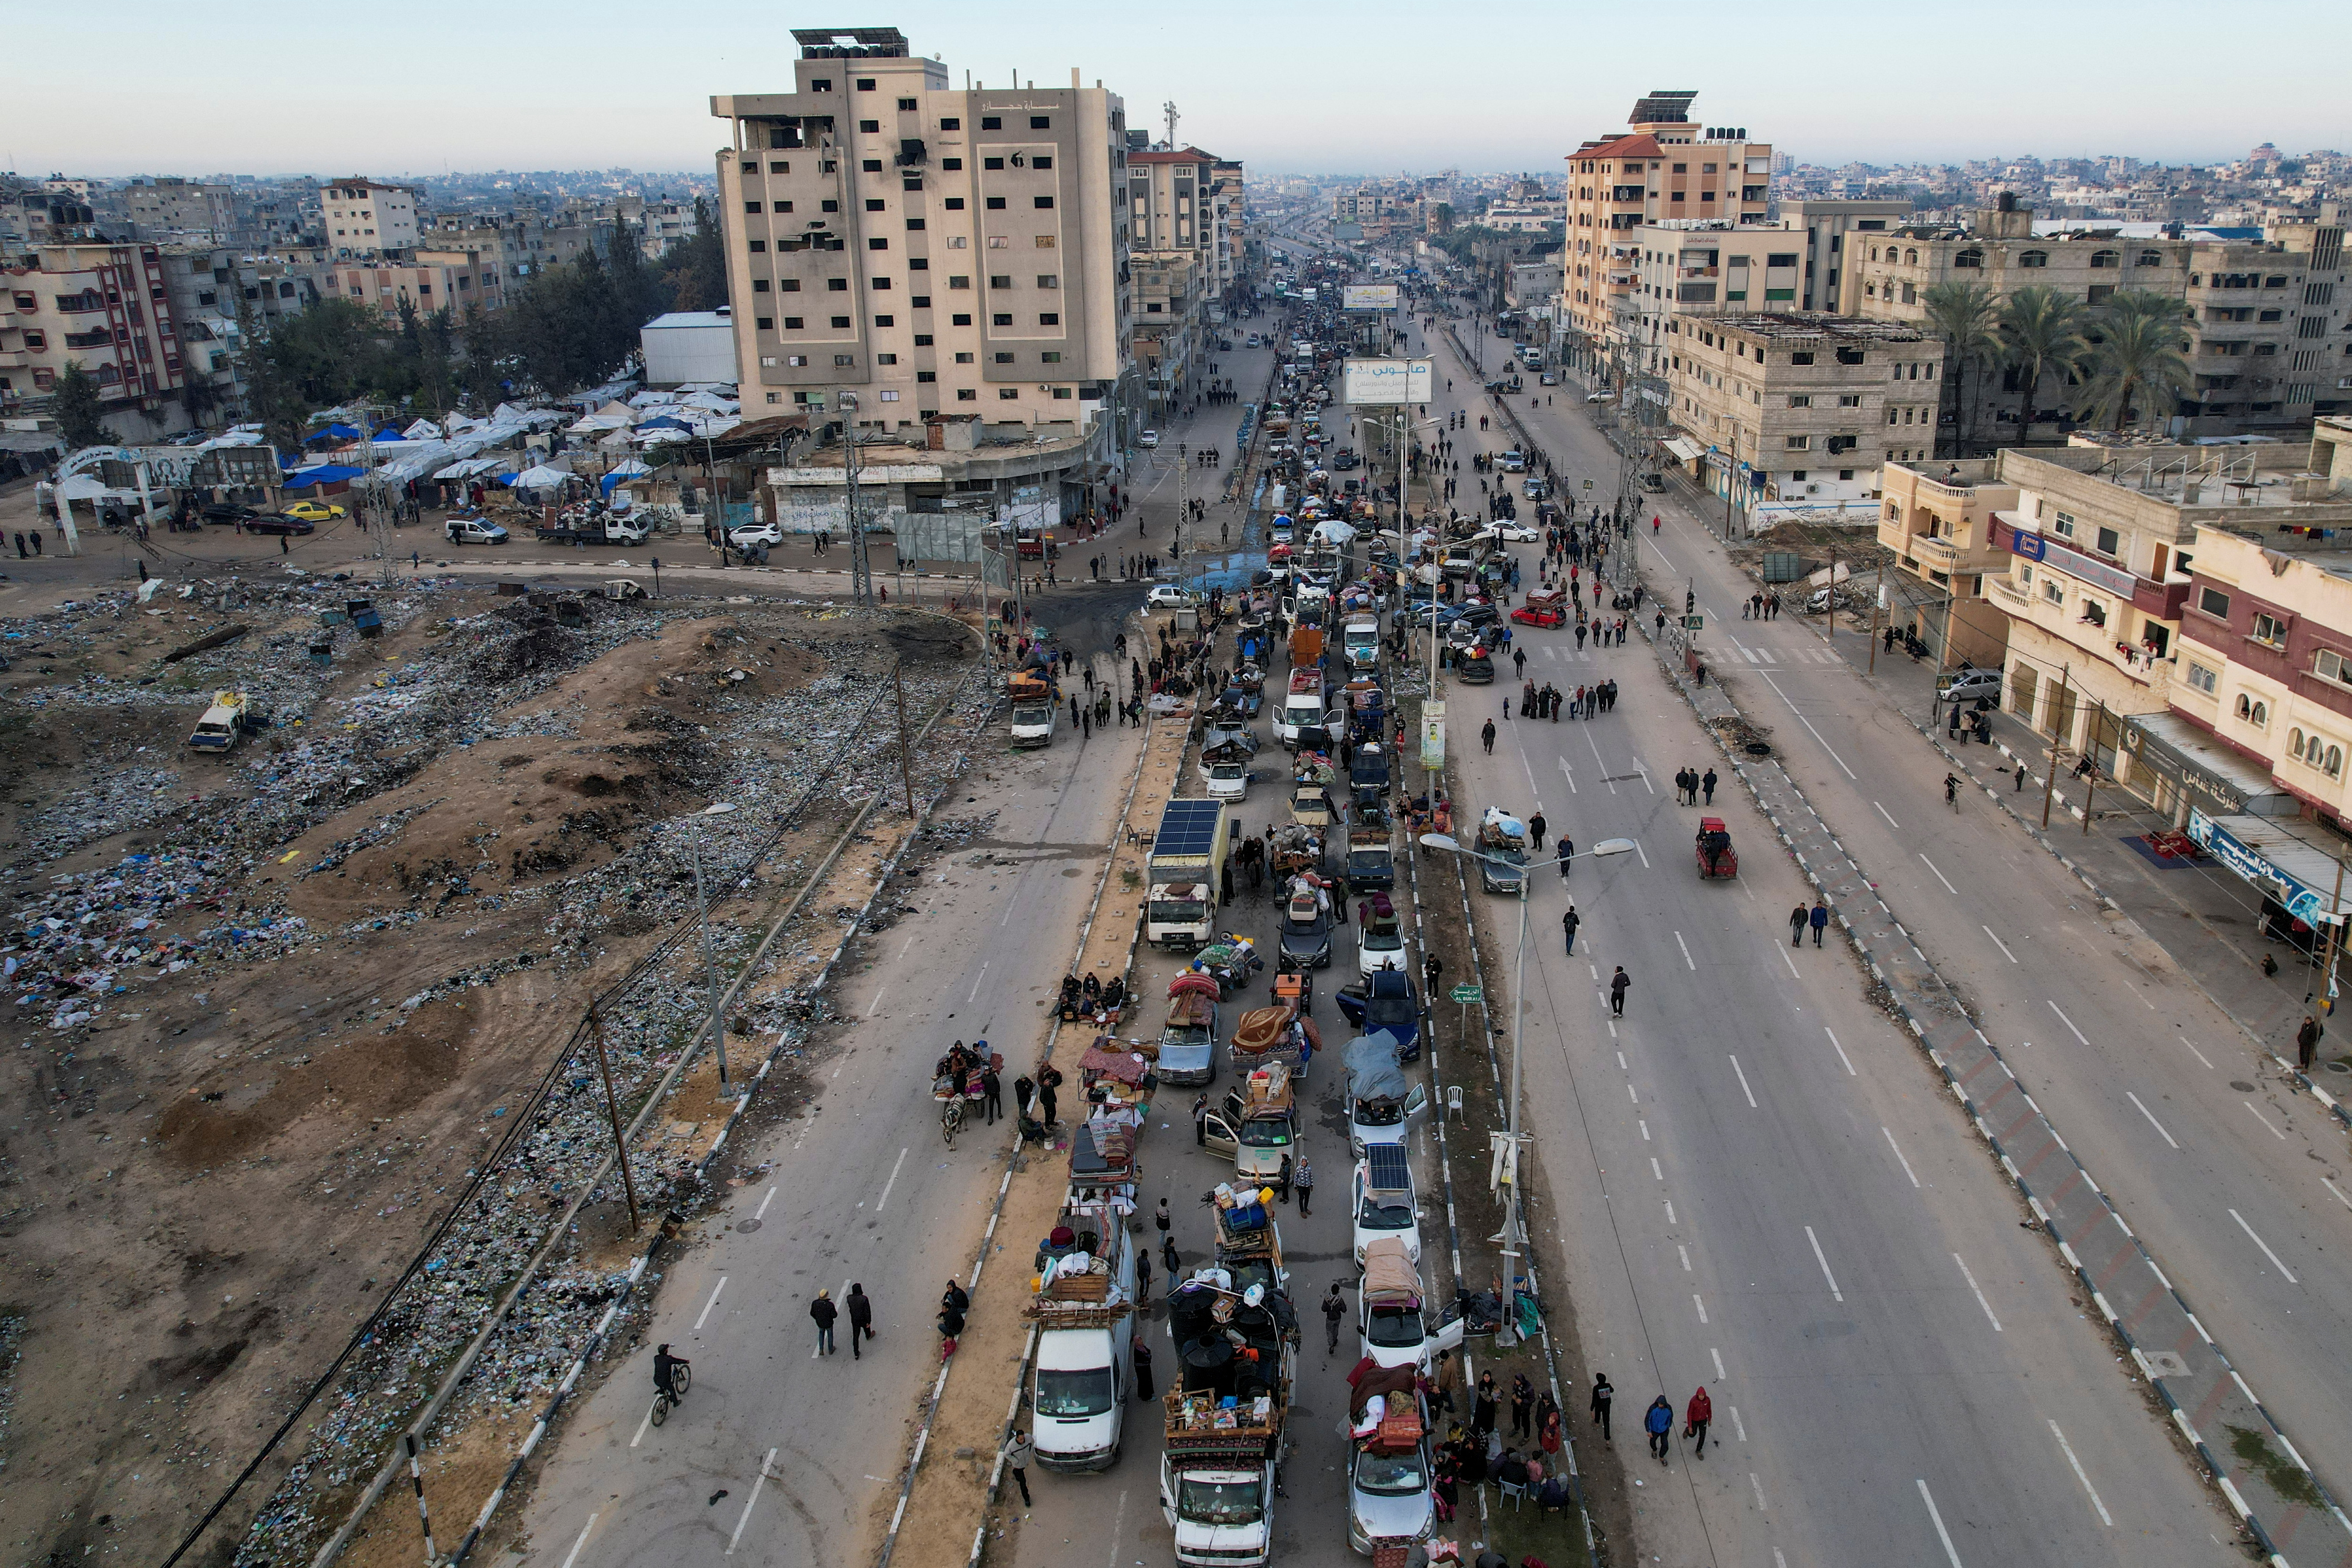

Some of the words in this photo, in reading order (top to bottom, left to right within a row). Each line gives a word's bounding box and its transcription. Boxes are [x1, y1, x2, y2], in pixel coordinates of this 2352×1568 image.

[981, 100, 1023, 112] حجازي
[1024, 100, 1059, 111] عمارة
[2210, 781, 2240, 813] شركة
